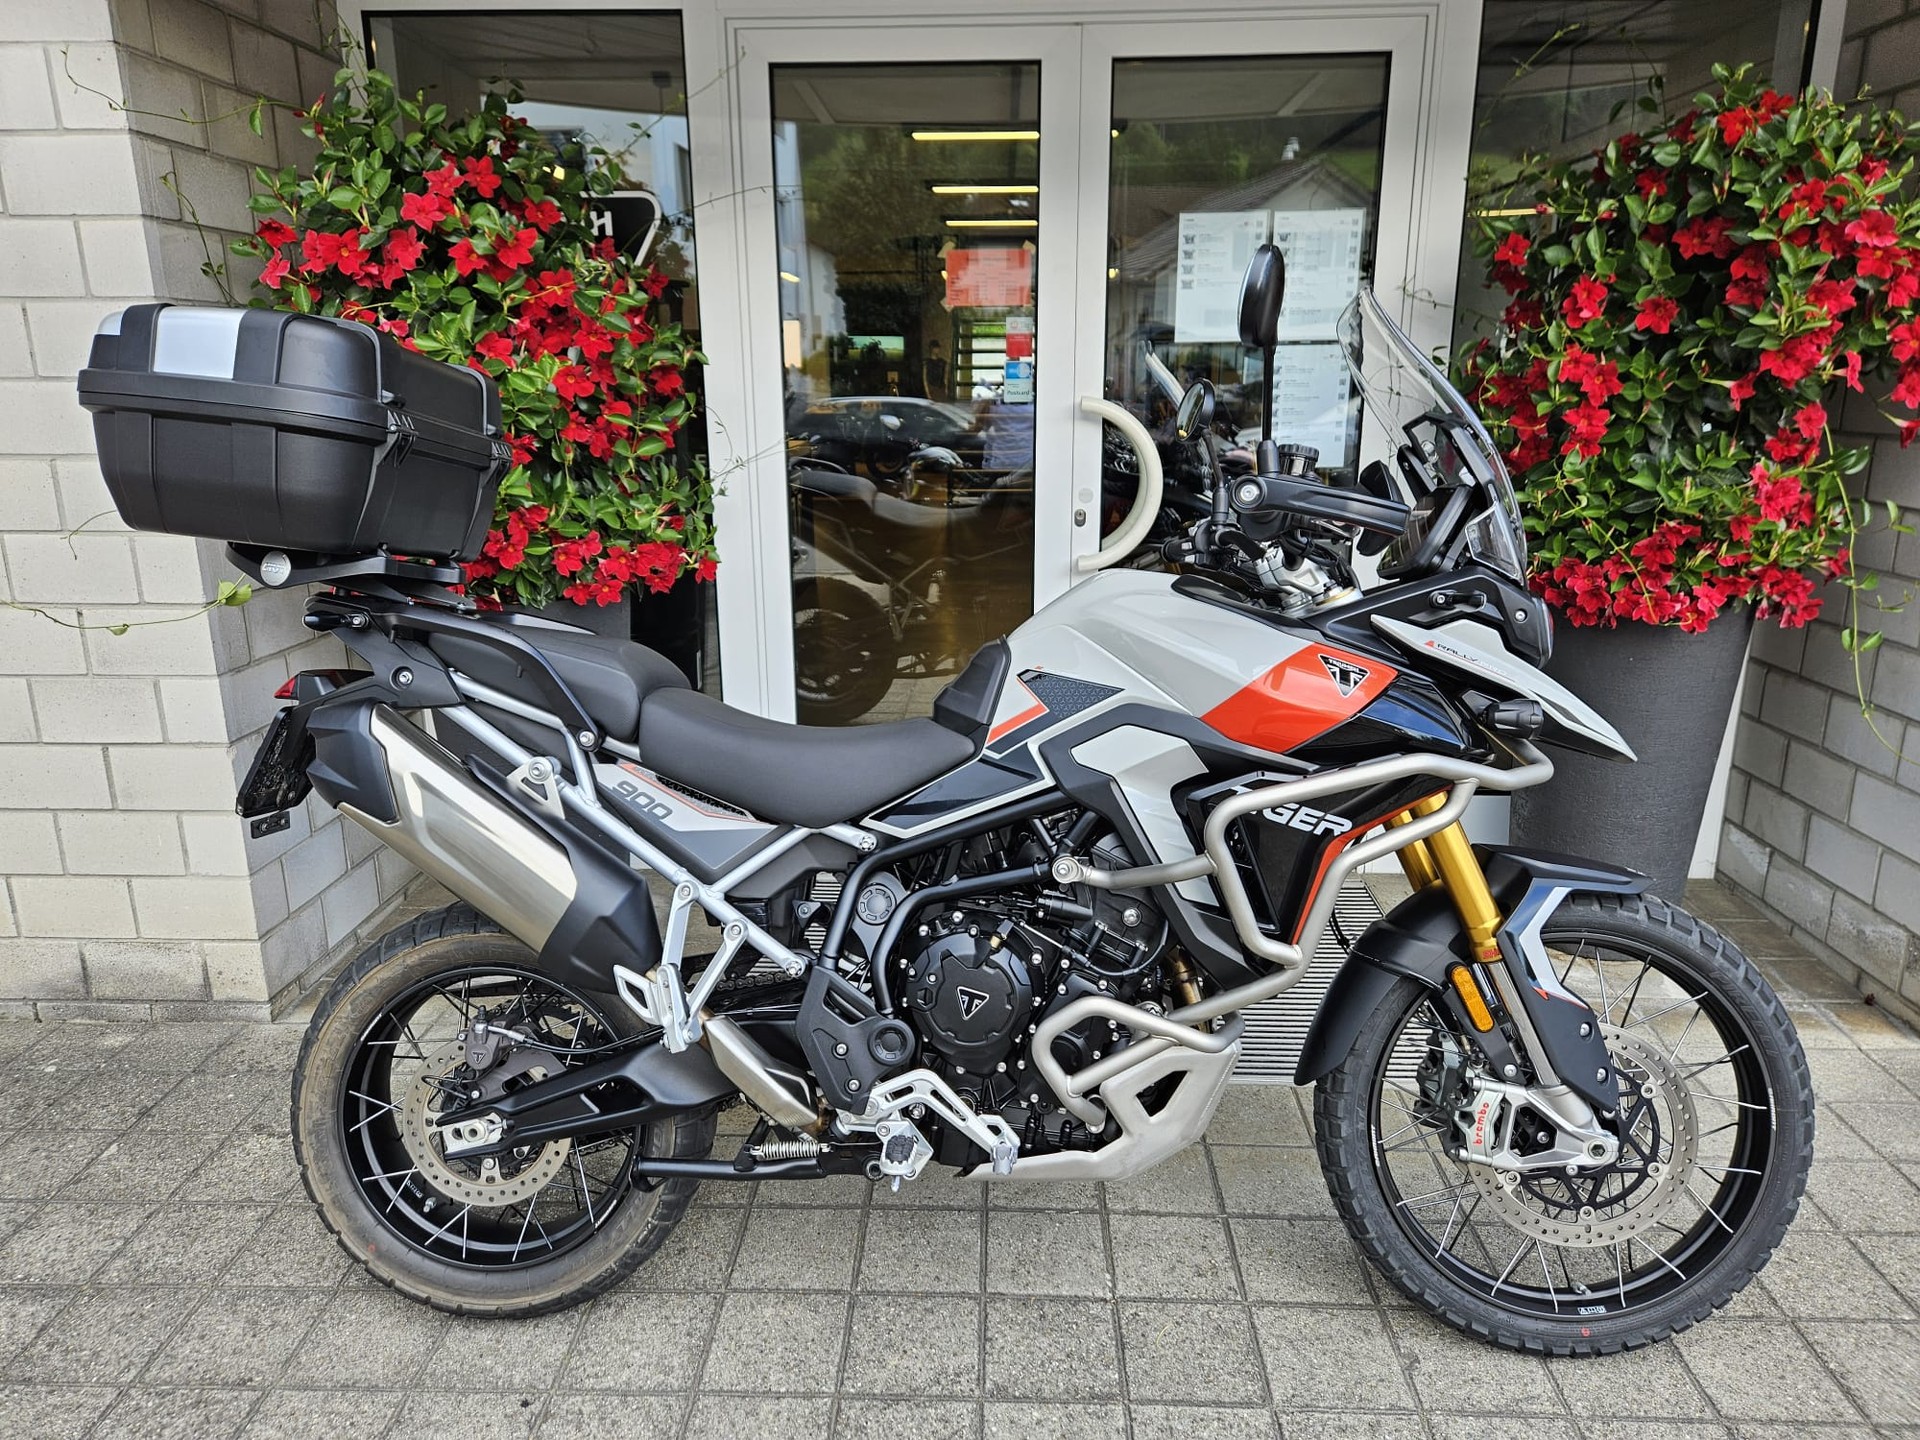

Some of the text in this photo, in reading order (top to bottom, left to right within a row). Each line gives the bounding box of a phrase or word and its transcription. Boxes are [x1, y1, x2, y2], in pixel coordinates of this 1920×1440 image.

[1437, 643, 1479, 662] RALLY
[611, 780, 674, 820] 900
[1472, 1102, 1489, 1145] brembo
